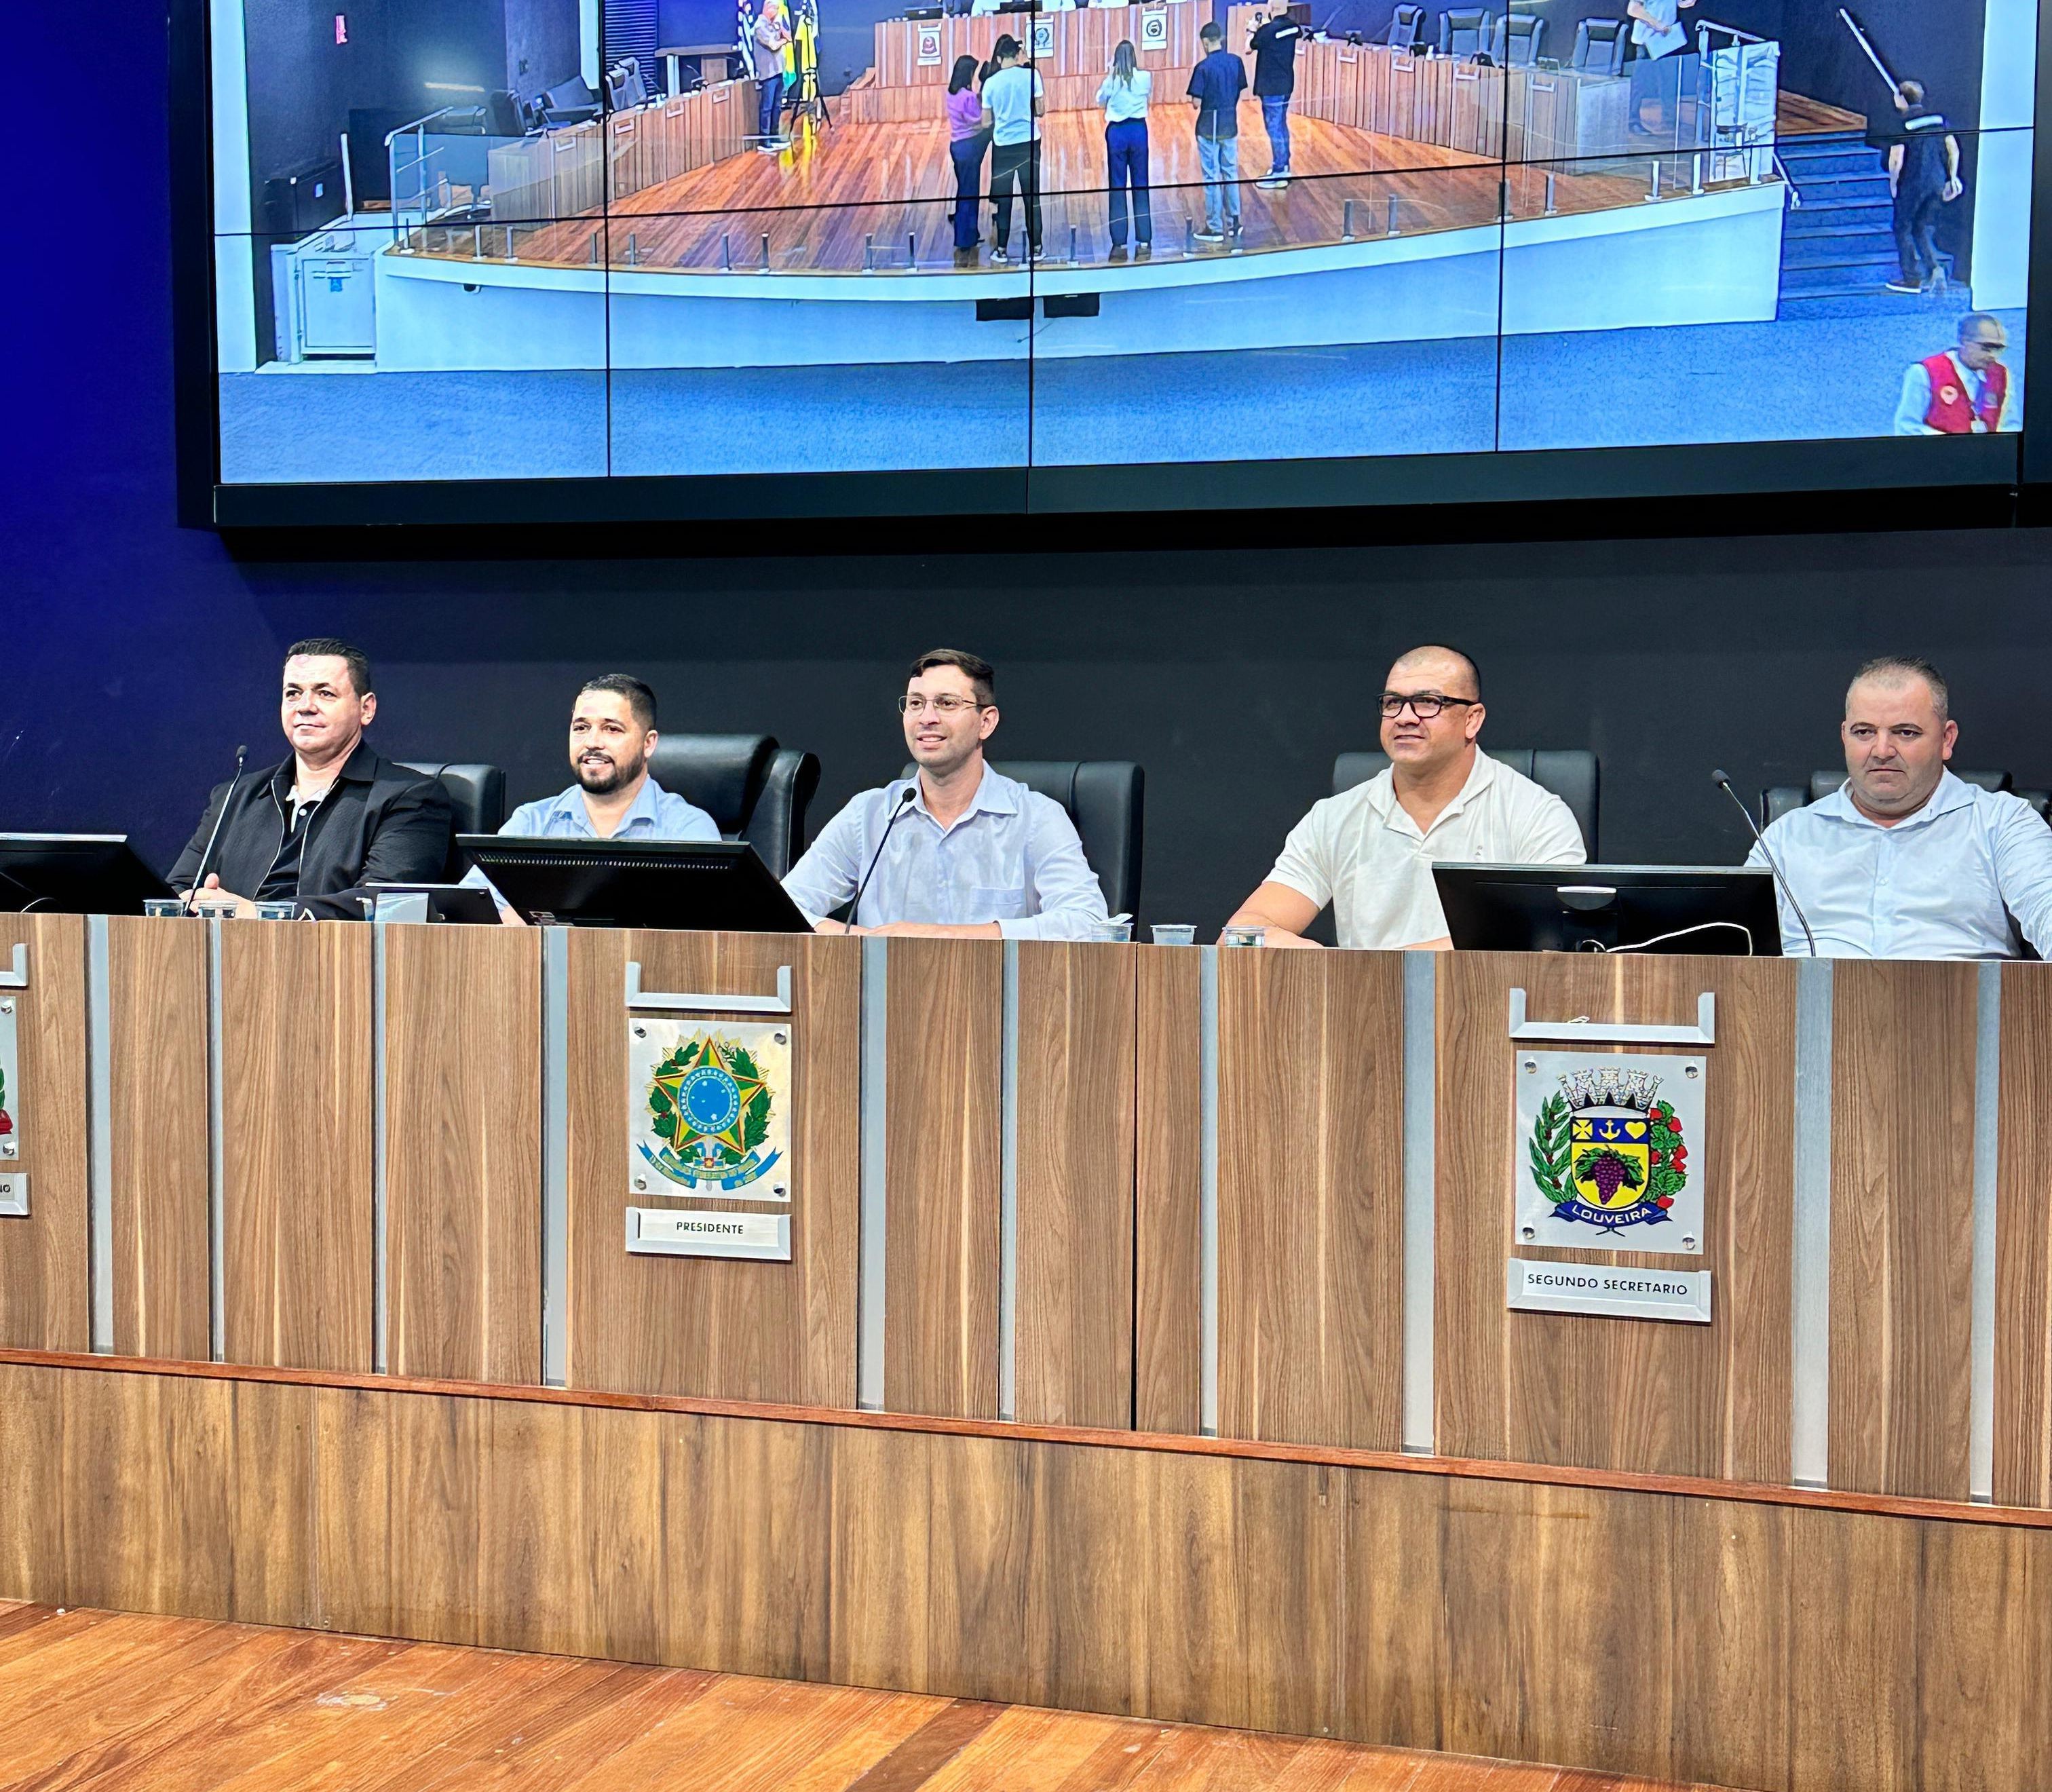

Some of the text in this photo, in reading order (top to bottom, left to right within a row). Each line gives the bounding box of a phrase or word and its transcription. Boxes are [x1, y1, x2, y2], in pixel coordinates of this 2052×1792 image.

[1572, 1204, 1652, 1223] LOUVEIRA
[677, 1221, 743, 1234] PRESIDENTE
[1527, 1274, 1688, 1295] SEGUNDO SECRETARIO
